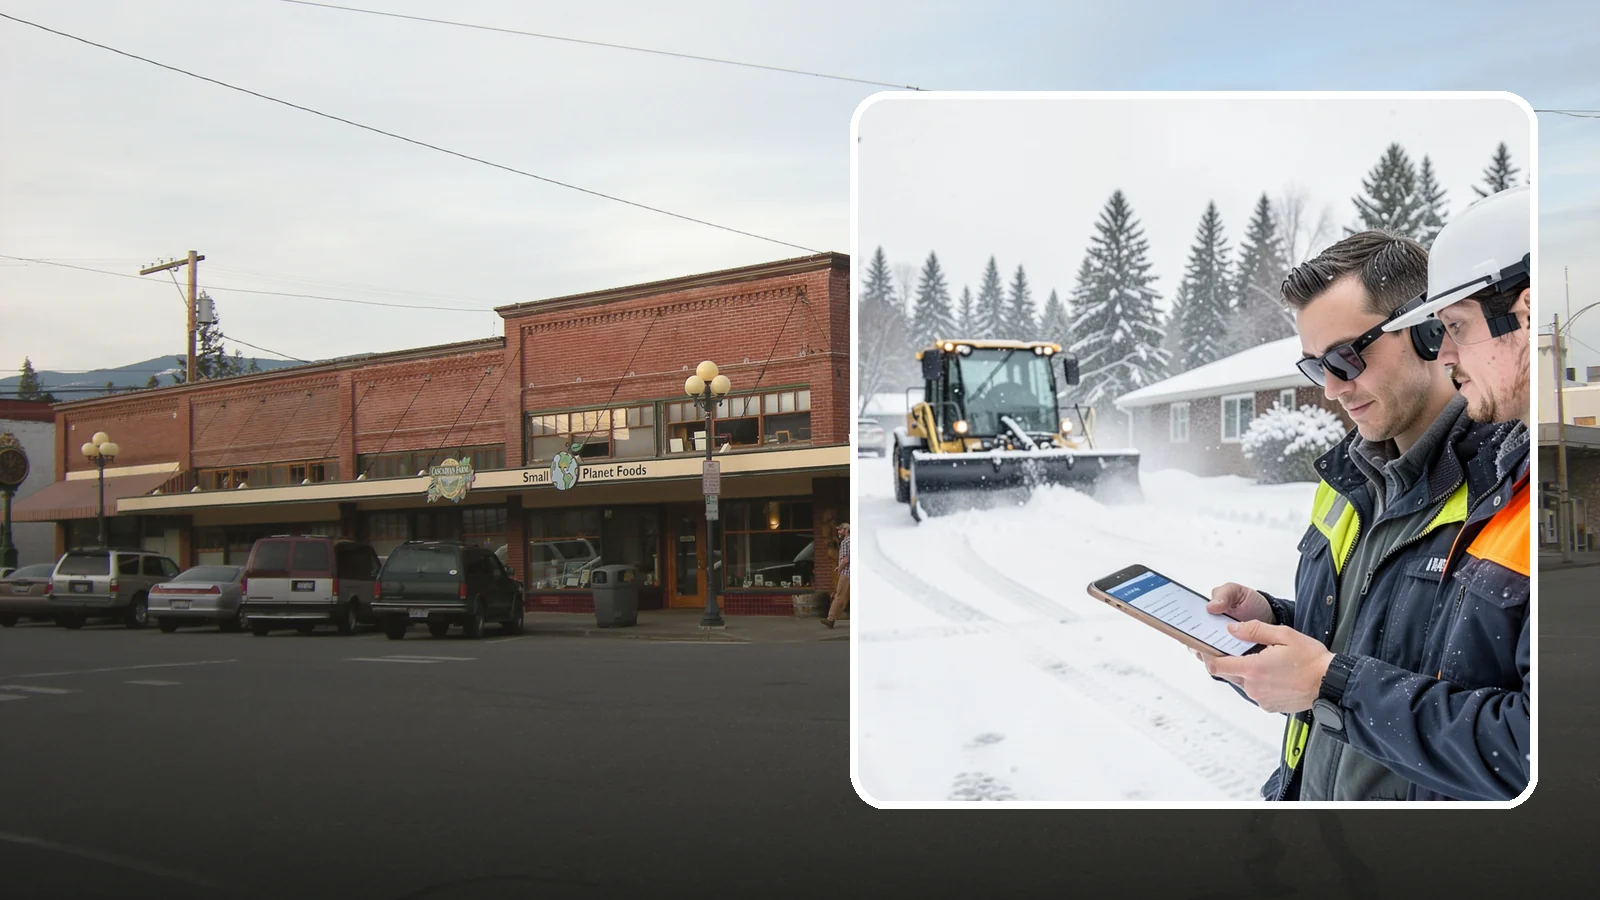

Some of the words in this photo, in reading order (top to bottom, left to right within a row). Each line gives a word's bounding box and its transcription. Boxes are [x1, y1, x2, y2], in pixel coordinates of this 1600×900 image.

[523, 471, 549, 483] Small
[583, 468, 614, 479] Planet
[617, 464, 647, 477] Foods
